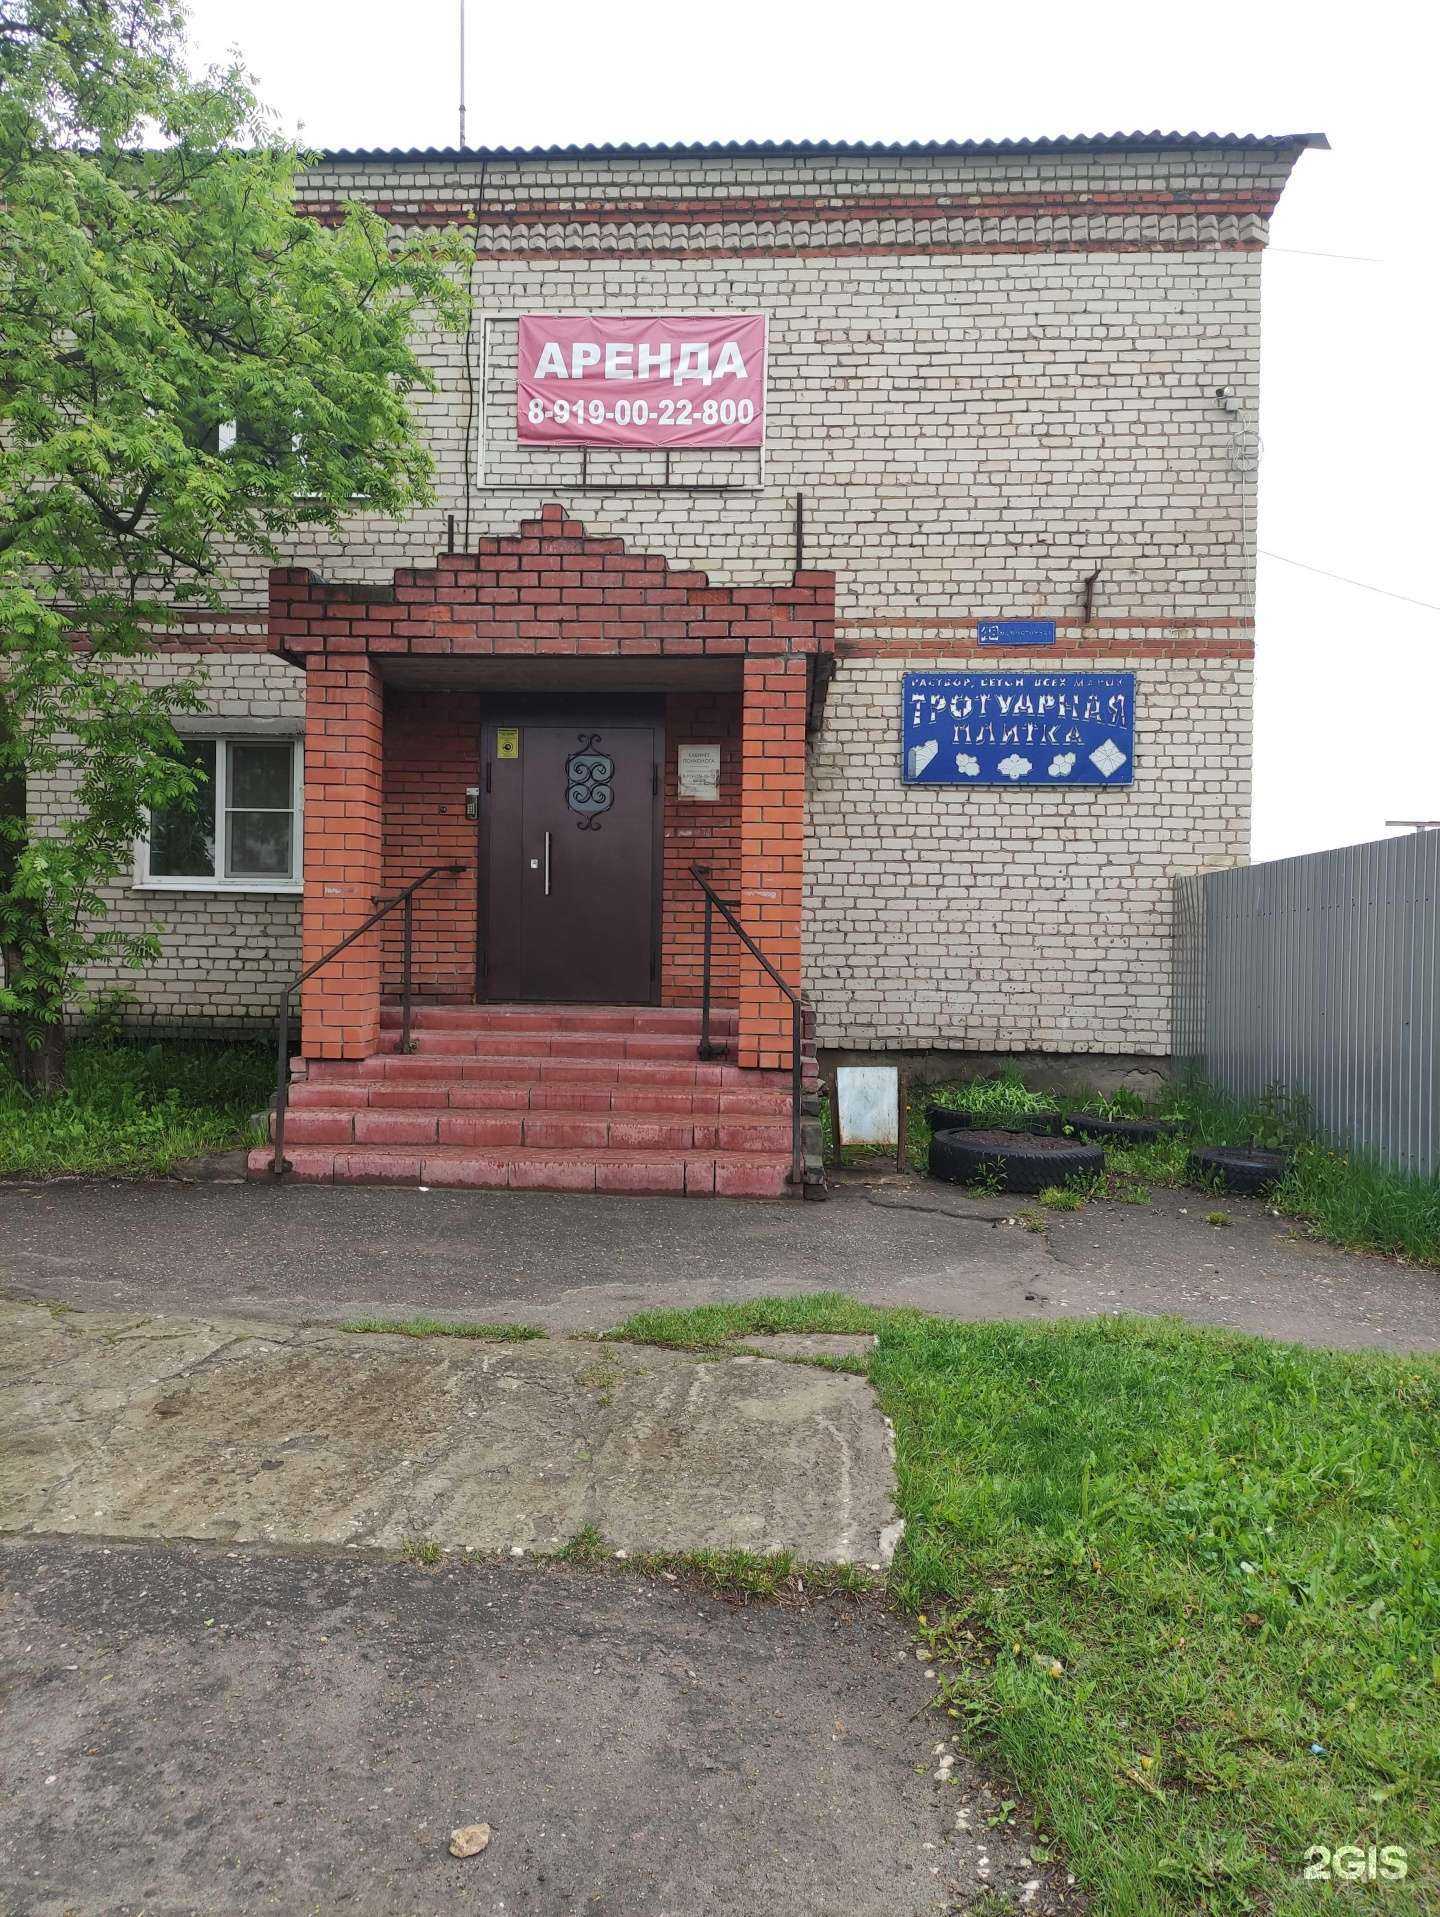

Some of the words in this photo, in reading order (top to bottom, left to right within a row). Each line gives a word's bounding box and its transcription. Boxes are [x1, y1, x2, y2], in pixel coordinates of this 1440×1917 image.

[534, 341, 749, 387] АРЕНДА
[527, 398, 754, 426] 8-919-00-22-800
[909, 693, 1127, 729] ТРОТУАРНАЯ
[952, 722, 1085, 746] ПЛИТКА
